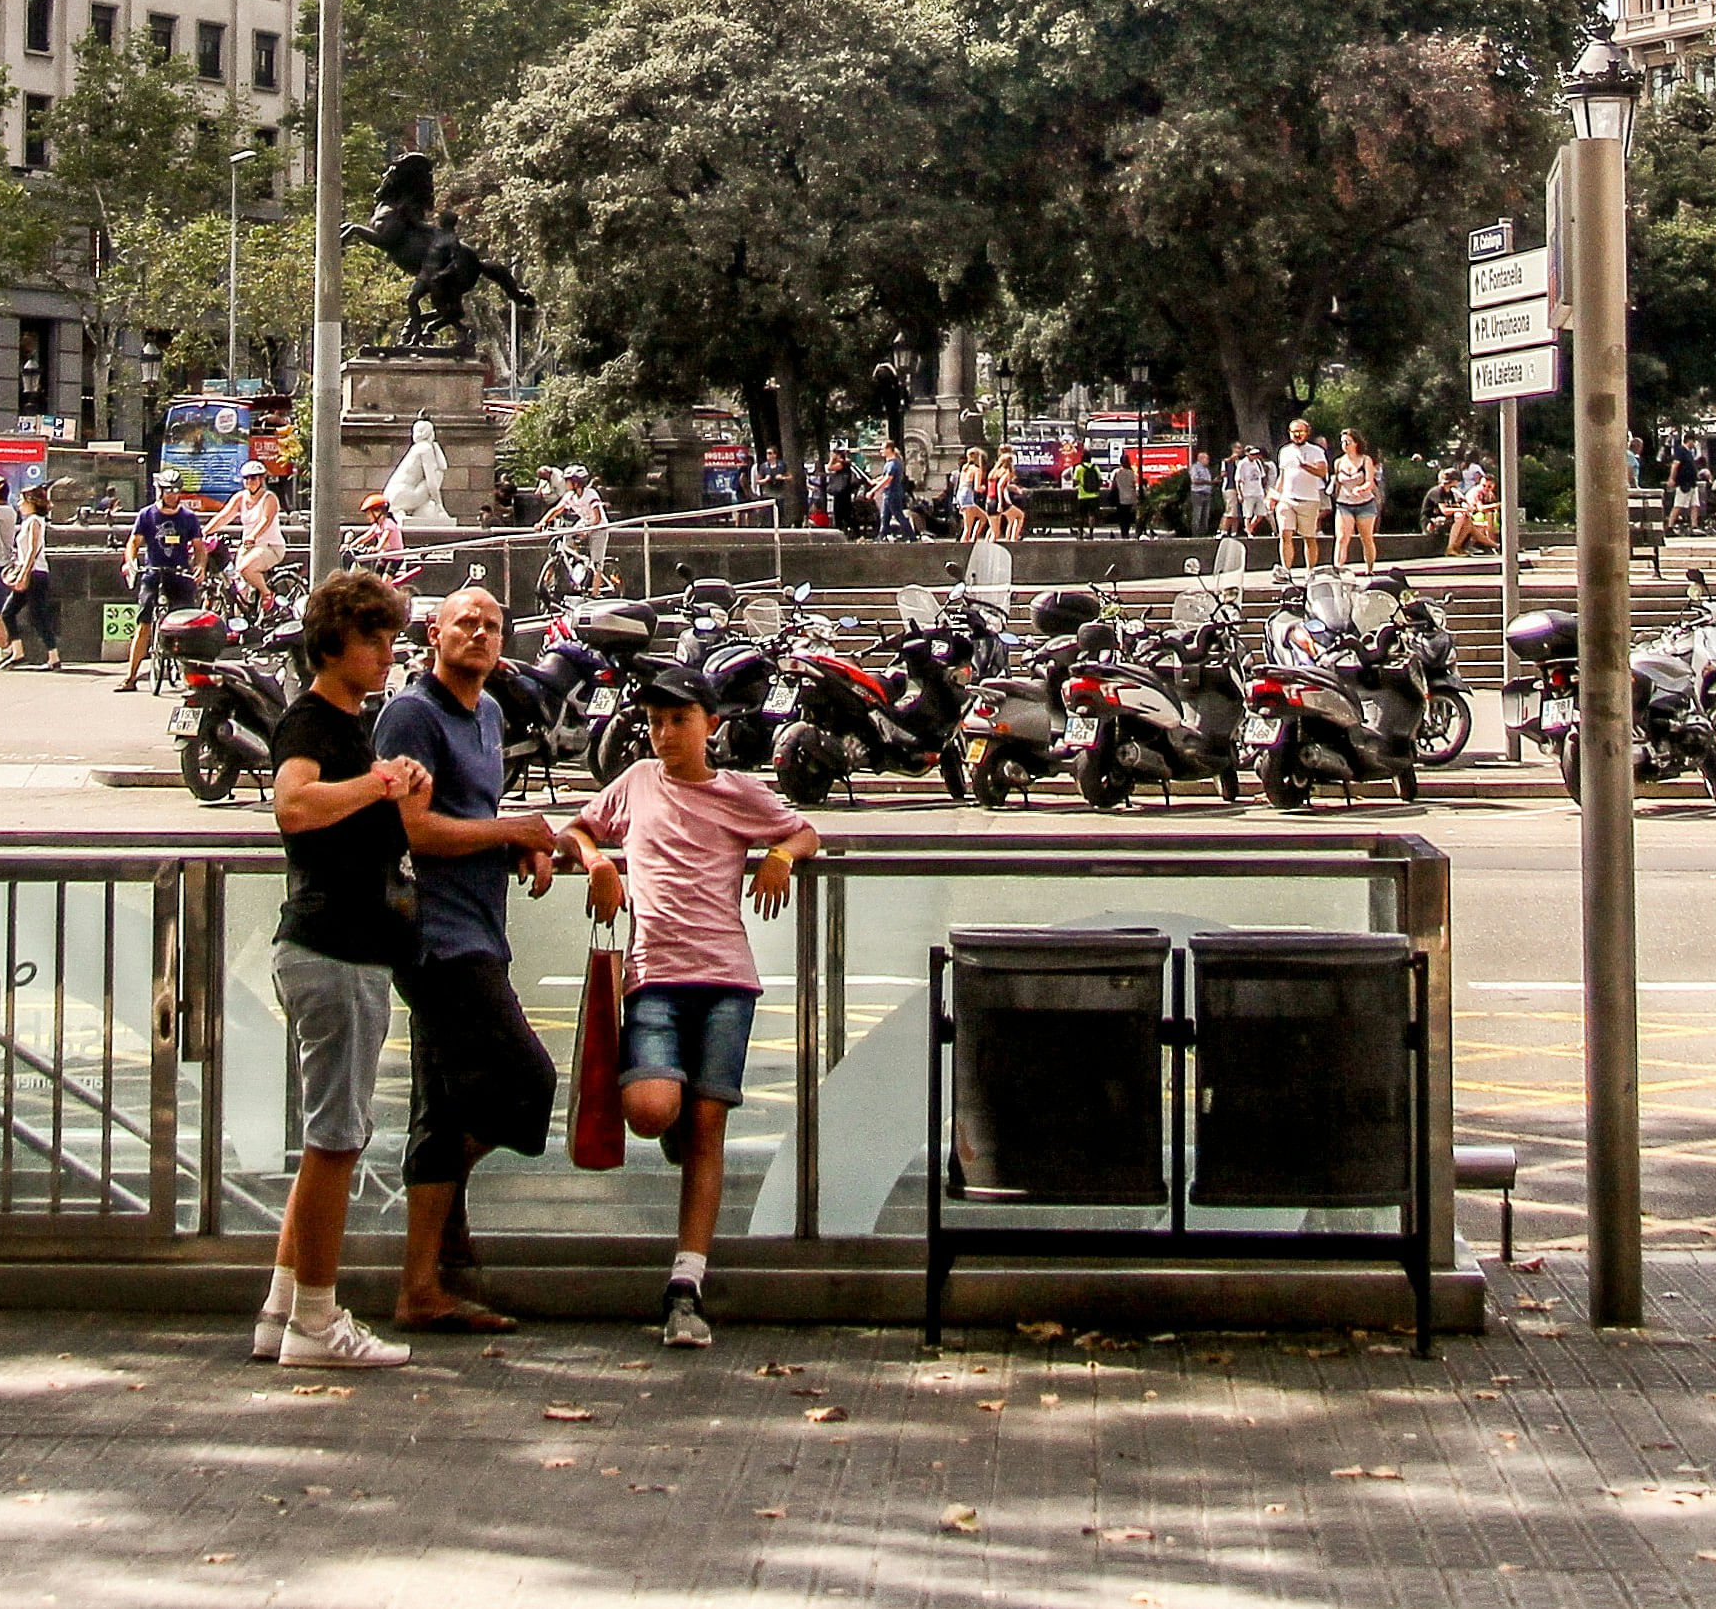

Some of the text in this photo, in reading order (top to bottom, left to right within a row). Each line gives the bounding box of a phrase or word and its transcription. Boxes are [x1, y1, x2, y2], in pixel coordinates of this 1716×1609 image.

[1489, 263, 1523, 291] Fontanella
[1491, 312, 1530, 343] Urquinaona
[1494, 361, 1523, 385] Laietana
